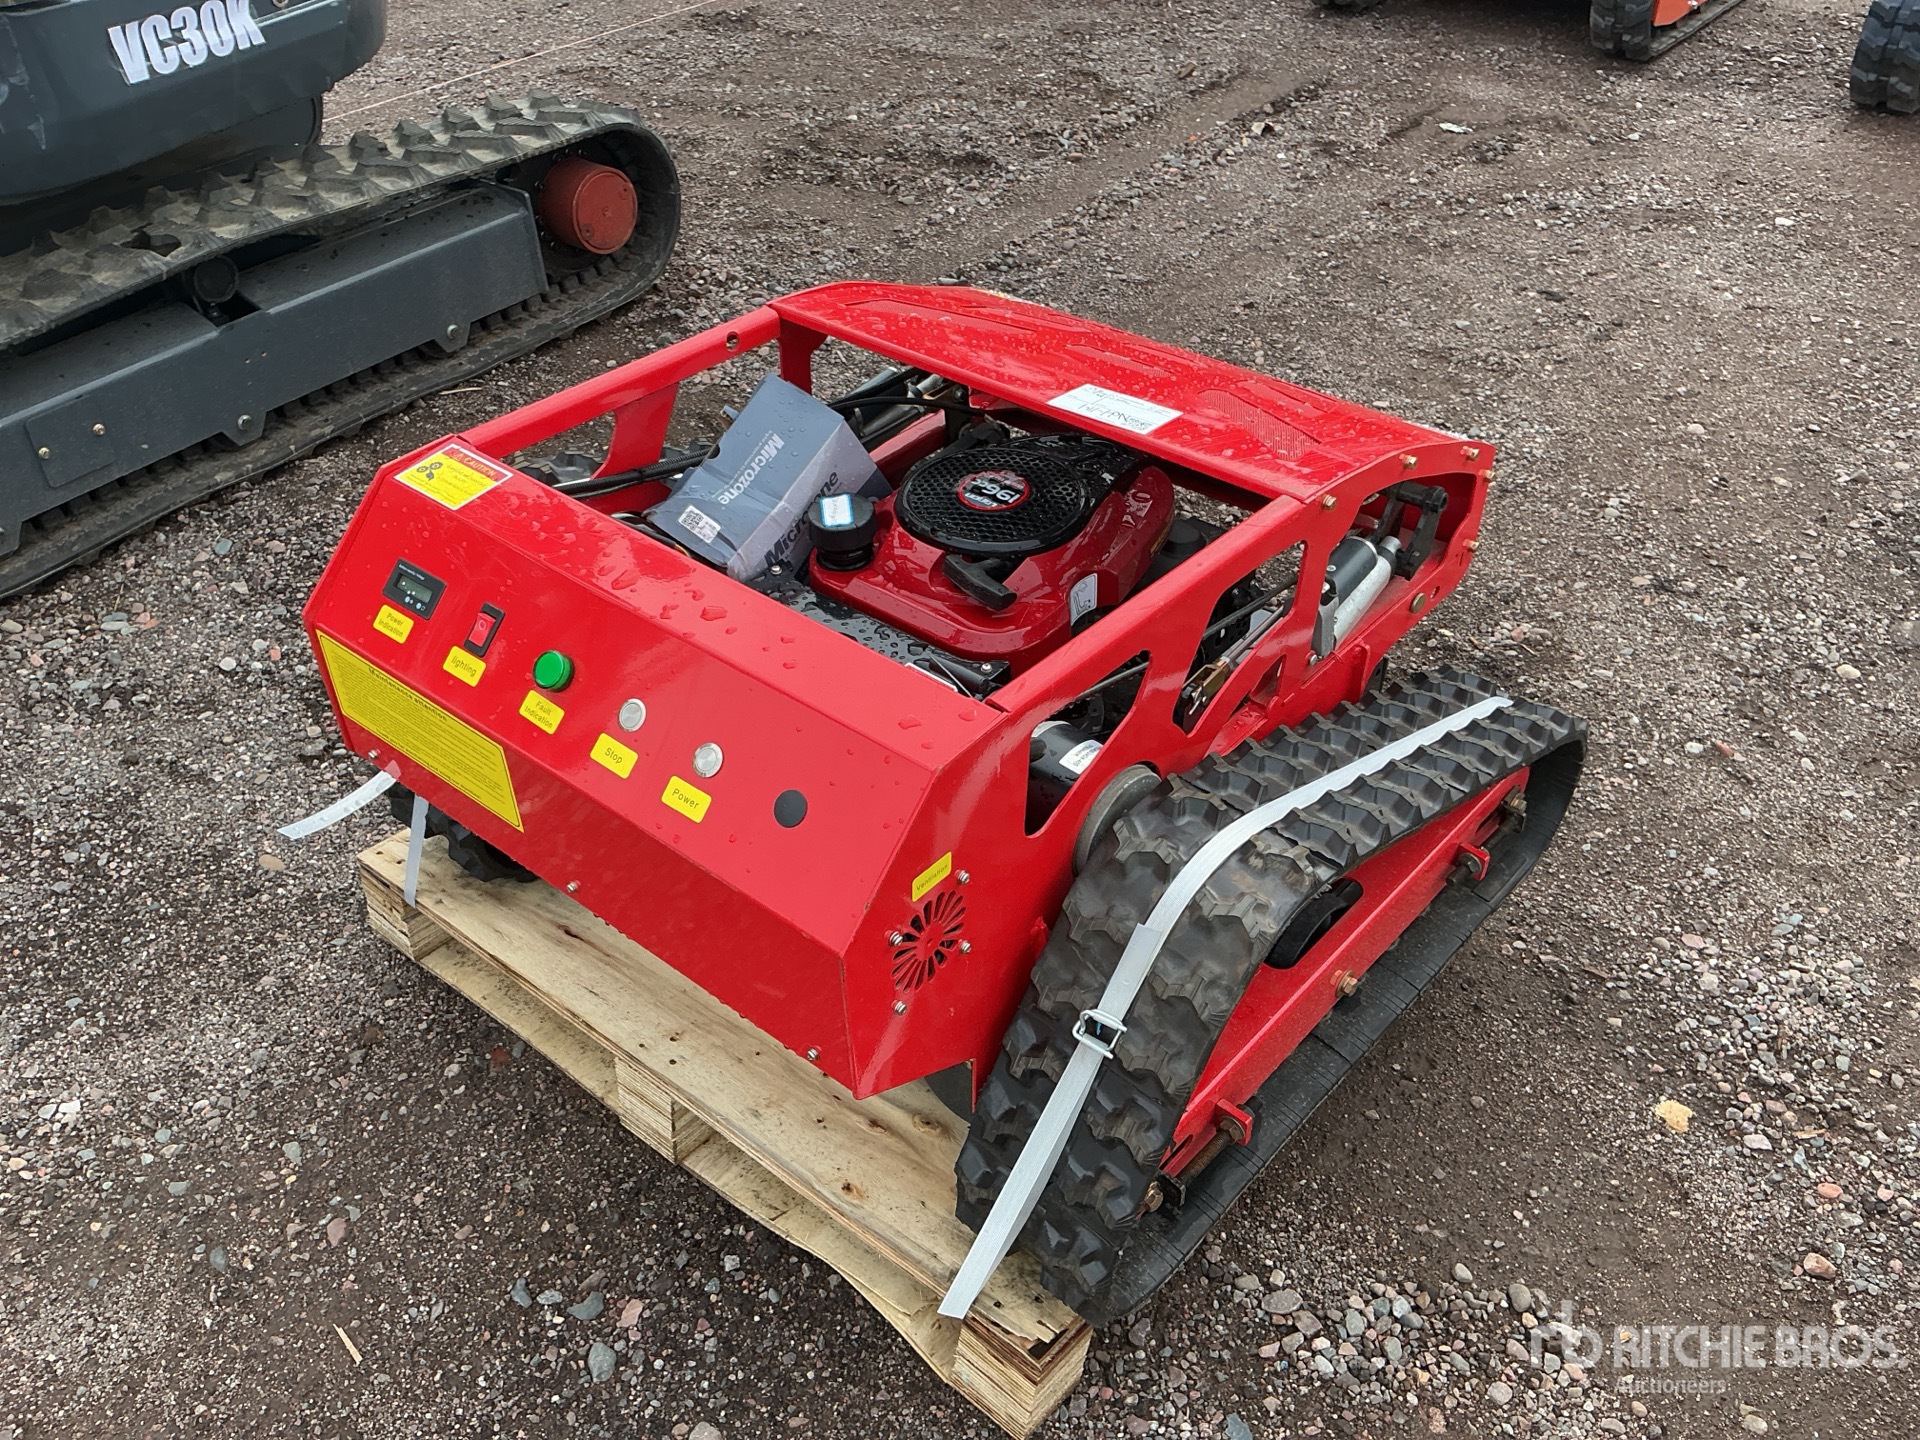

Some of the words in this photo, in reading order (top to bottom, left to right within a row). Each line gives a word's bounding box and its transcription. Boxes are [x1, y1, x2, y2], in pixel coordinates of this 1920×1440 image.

[107, 0, 267, 85] VC30K
[463, 457, 496, 477] CAUTION
[718, 433, 785, 505] Microzone
[970, 478, 1020, 504] 196cc
[764, 472, 839, 566] Microne
[386, 613, 404, 626] Power
[451, 656, 477, 678] lighting
[524, 705, 553, 729] Indication
[535, 701, 552, 716] Fault
[604, 747, 623, 765] Stop
[672, 788, 699, 809] Power
